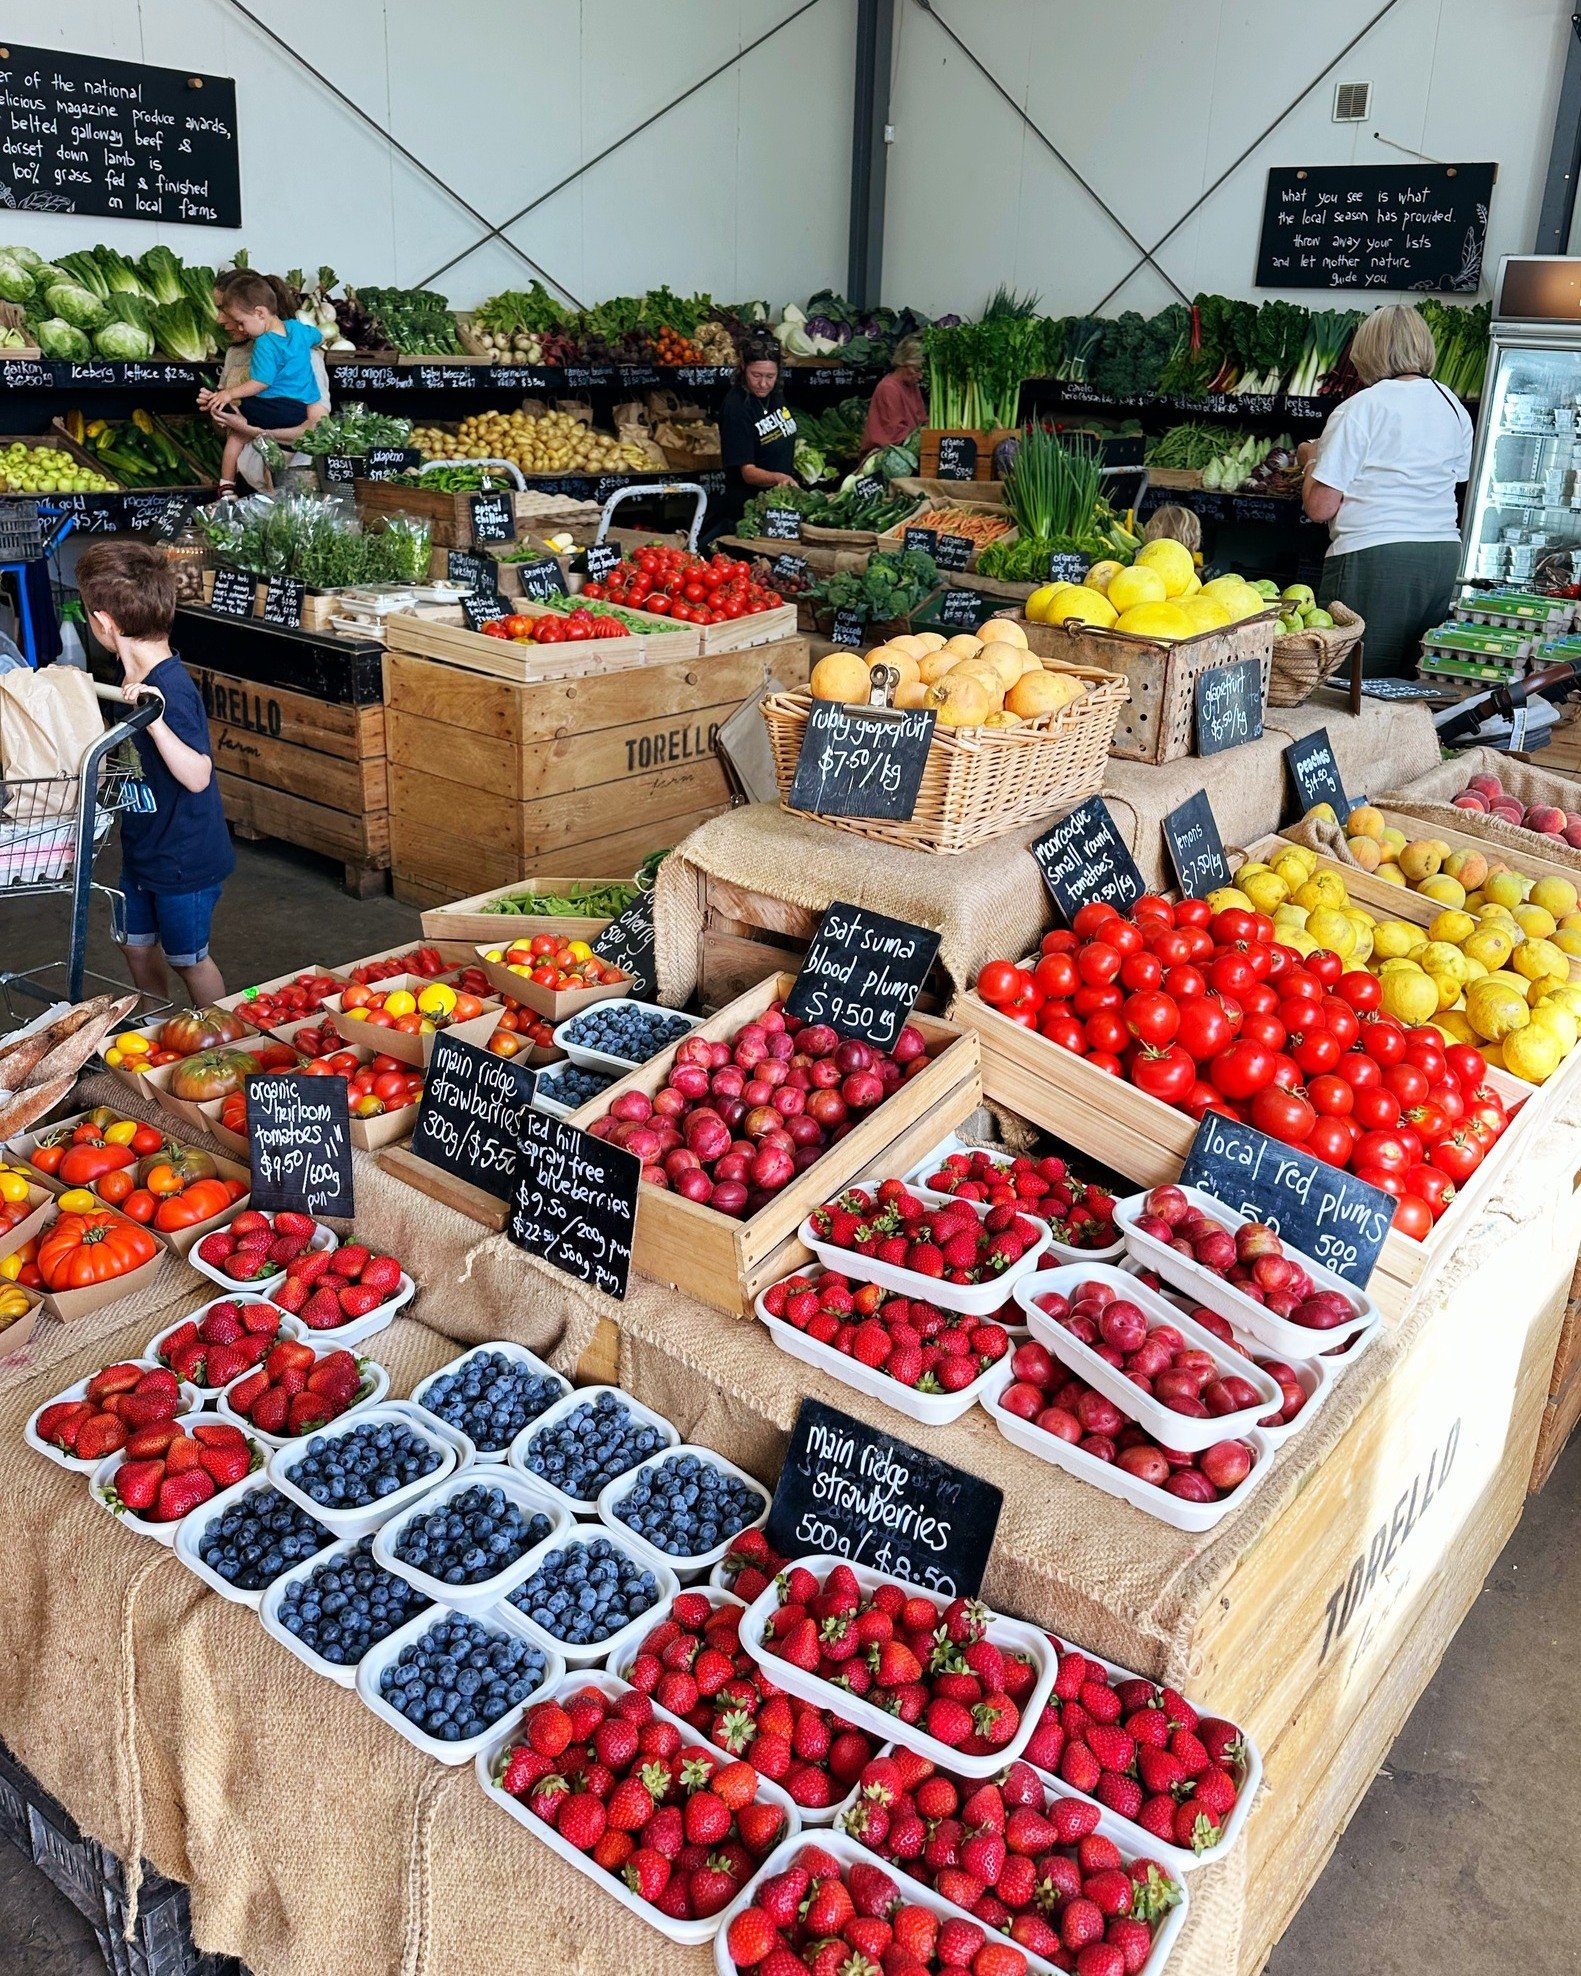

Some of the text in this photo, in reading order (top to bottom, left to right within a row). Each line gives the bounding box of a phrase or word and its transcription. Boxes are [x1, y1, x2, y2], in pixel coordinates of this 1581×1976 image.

[25, 71, 41, 88] of
[51, 73, 75, 92] the
[85, 79, 142, 103] national
[11, 112, 192, 153] belted galloway beef &
[57, 100, 118, 118] magazine
[132, 109, 175, 127] produce
[186, 117, 231, 140] awards,
[3, 137, 162, 171] dorset down lamb is
[12, 162, 208, 196] 100% grass fed & finished
[109, 194, 217, 219] on local farms
[1282, 187, 1430, 207] what you see is what
[1278, 208, 1456, 231] the local season has provided.
[1293, 234, 1431, 253] throw away your lists
[1273, 253, 1411, 268] and let mother nature
[1329, 272, 1357, 286] guide
[124, 364, 159, 383] lettuce
[334, 366, 393, 378] salad onions
[421, 366, 440, 381] baby
[1285, 396, 1310, 410] leeks
[328, 457, 352, 470] basil
[475, 498, 501, 517] spiral
[475, 513, 509, 524] chillies
[907, 531, 929, 543] organic
[1053, 553, 1082, 565] organic
[1203, 665, 1248, 721] grapefruit
[812, 704, 851, 740] ruby
[217, 728, 261, 757] farm
[625, 723, 719, 771] TORELLO
[818, 745, 901, 791] $7.50/kg
[1296, 748, 1331, 781] peaches
[1048, 822, 1115, 885] small round
[1173, 823, 1202, 856] lemons
[1065, 852, 1114, 901] tomatoes
[601, 925, 626, 944] 500
[803, 944, 918, 1006] blood plums
[437, 1047, 518, 1102] main ridge
[250, 1078, 299, 1115] organic
[274, 1097, 331, 1123] heirloom
[431, 1072, 521, 1137] strawberries
[255, 1121, 322, 1150] tomatoes
[556, 1123, 582, 1154] hill
[517, 1138, 605, 1185] spray free
[537, 1164, 631, 1220] blueberries
[1204, 1118, 1268, 1180] local
[1274, 1160, 1318, 1205] red
[1316, 1184, 1388, 1243] plums
[308, 1191, 327, 1215] pun
[1314, 1234, 1357, 1262] 500
[860, 1444, 909, 1503] ridge
[812, 1466, 951, 1552] strawberries
[1317, 1417, 1461, 1666] TORELLO
